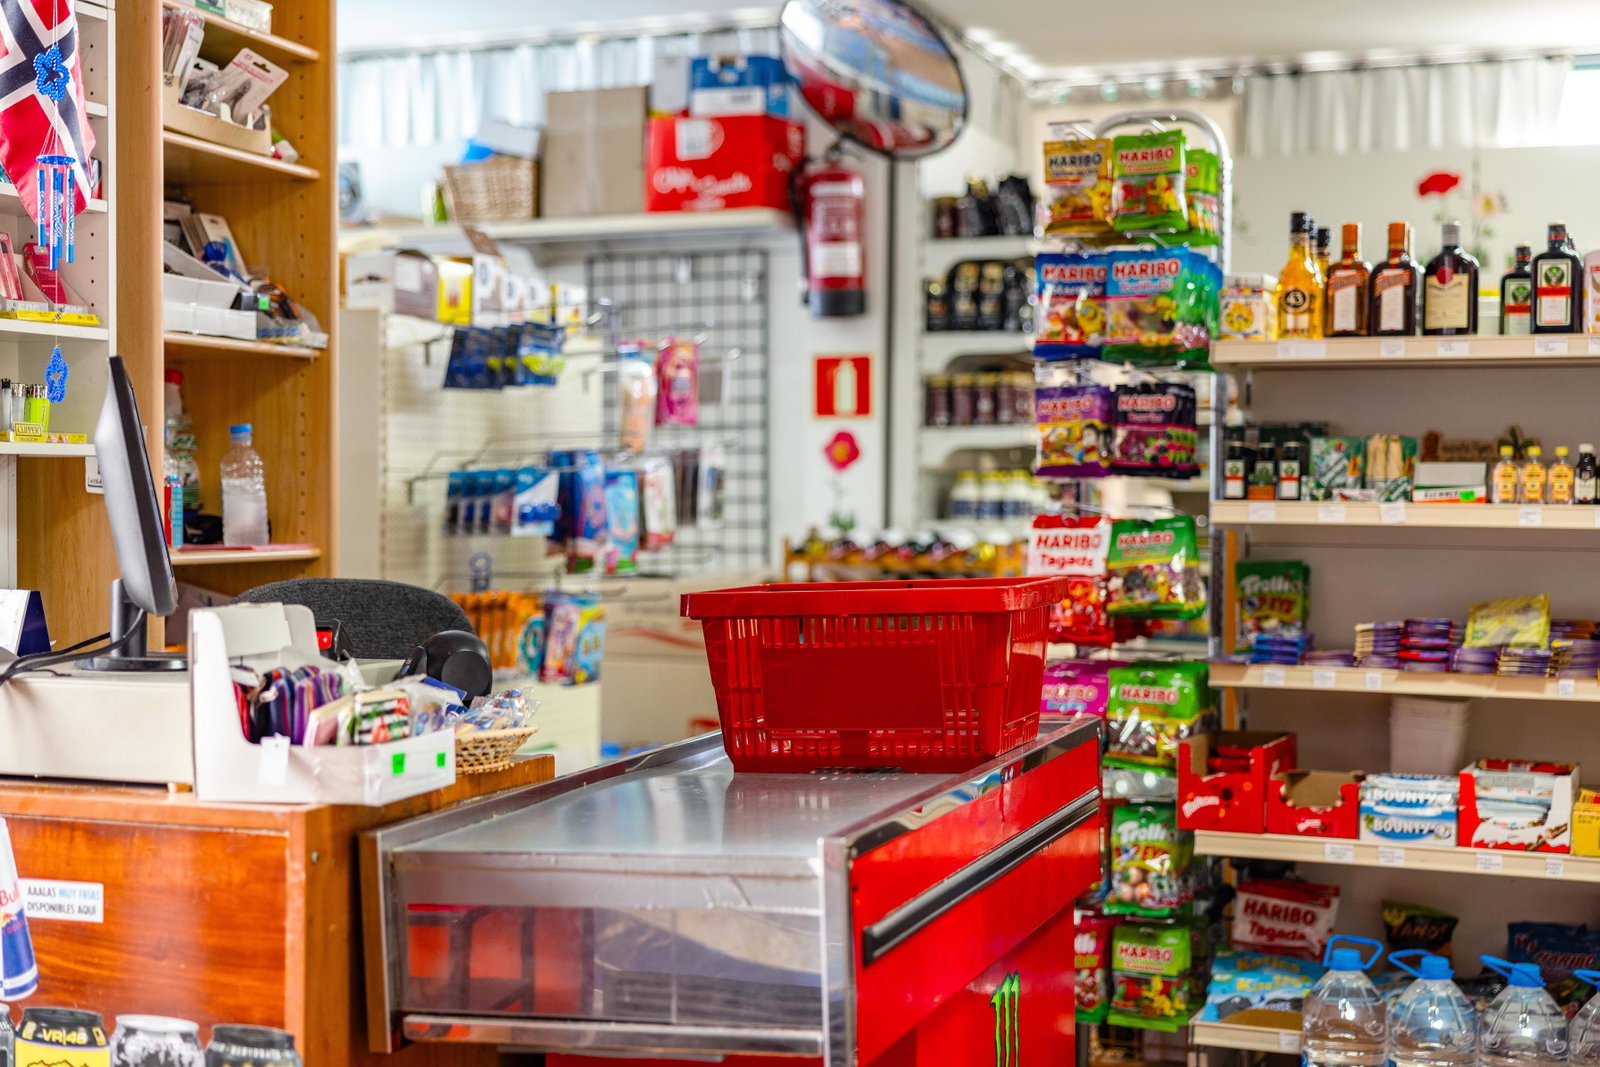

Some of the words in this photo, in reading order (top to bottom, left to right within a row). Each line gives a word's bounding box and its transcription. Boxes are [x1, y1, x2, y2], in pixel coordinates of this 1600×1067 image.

[1049, 151, 1103, 169] HARIBO
[1118, 146, 1176, 164] HARIBO
[1042, 263, 1108, 282] HARIBO
[1112, 259, 1181, 278] HARIBO
[1039, 395, 1093, 413] HARIBO
[1118, 394, 1176, 411] HARIBO
[17, 425, 40, 435] CLIPPER
[1035, 533, 1102, 550] HARIBO
[1117, 529, 1175, 548] HARIBO
[1240, 574, 1291, 595] Trolli
[1119, 685, 1179, 704] HARIBO
[1373, 788, 1436, 804] BOUNTY
[1117, 820, 1168, 844] Trolli
[1373, 817, 1433, 835] BOUNTY
[27, 901, 76, 914] DISPONIBLES
[1242, 898, 1318, 926] HARIBO
[1248, 920, 1307, 942] Tagada
[1118, 942, 1173, 963] HARIBO
